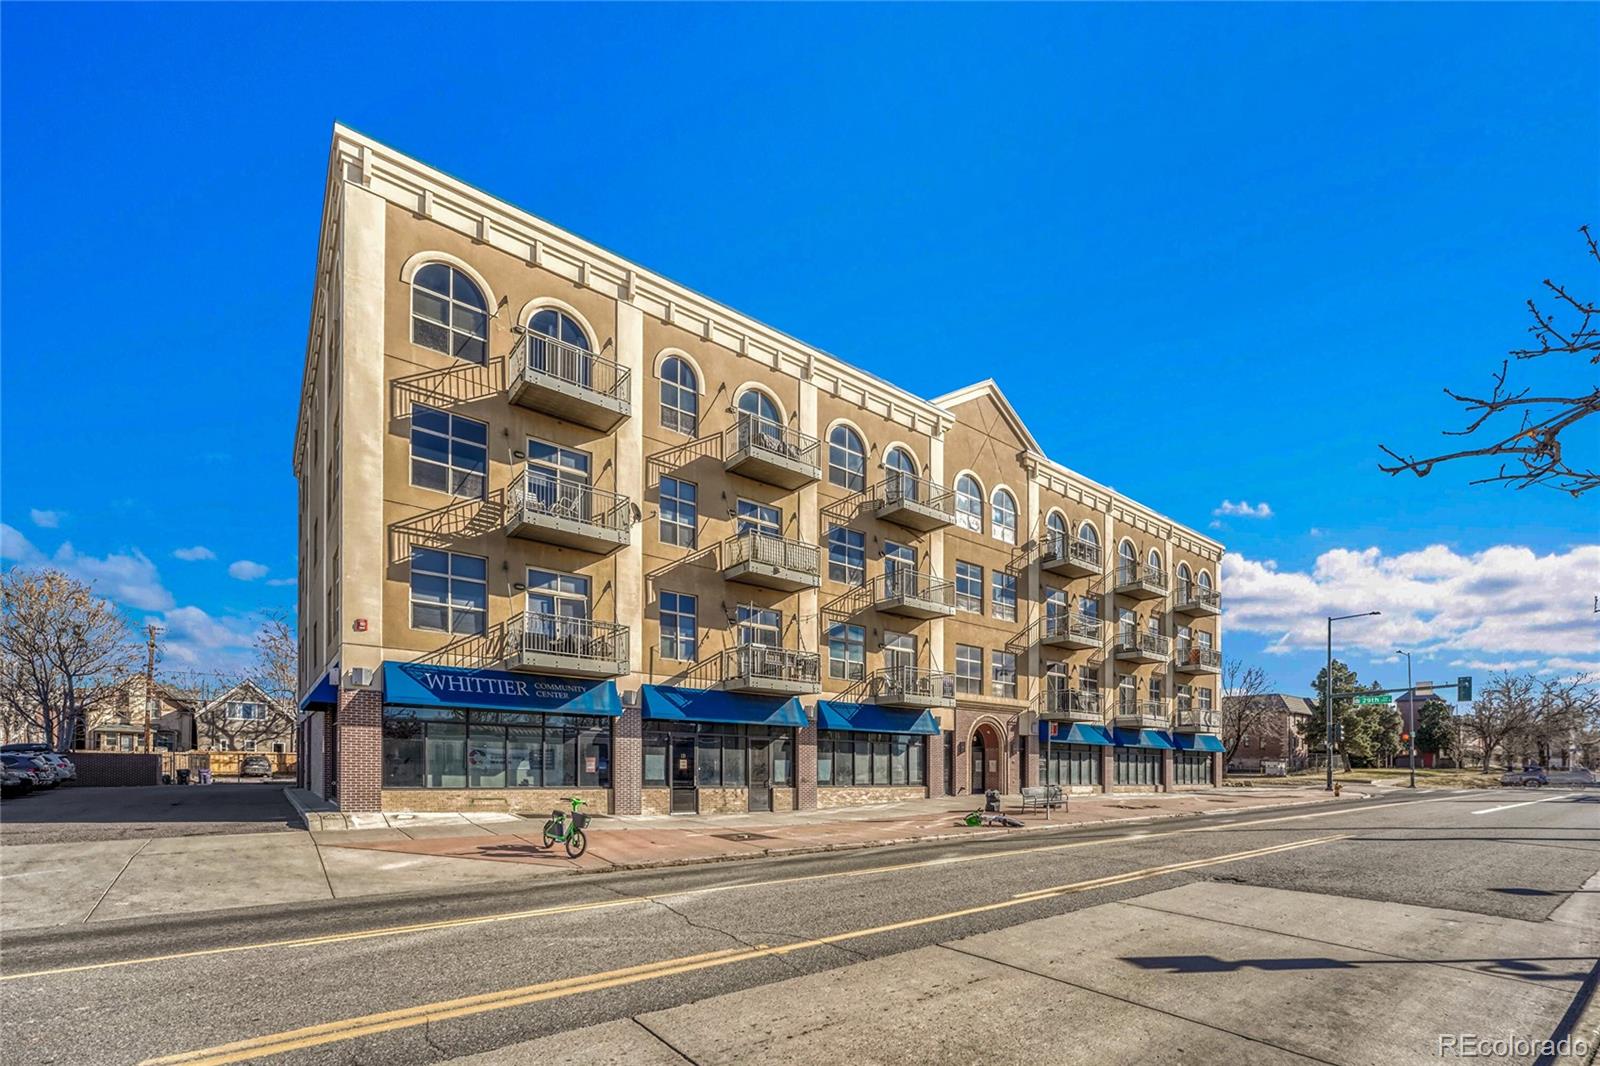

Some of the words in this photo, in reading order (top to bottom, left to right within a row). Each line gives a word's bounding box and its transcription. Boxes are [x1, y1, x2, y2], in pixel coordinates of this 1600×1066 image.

[425, 672, 530, 697] WHITTIER
[534, 682, 587, 692] COMMUNITY
[536, 690, 570, 699] CENTER
